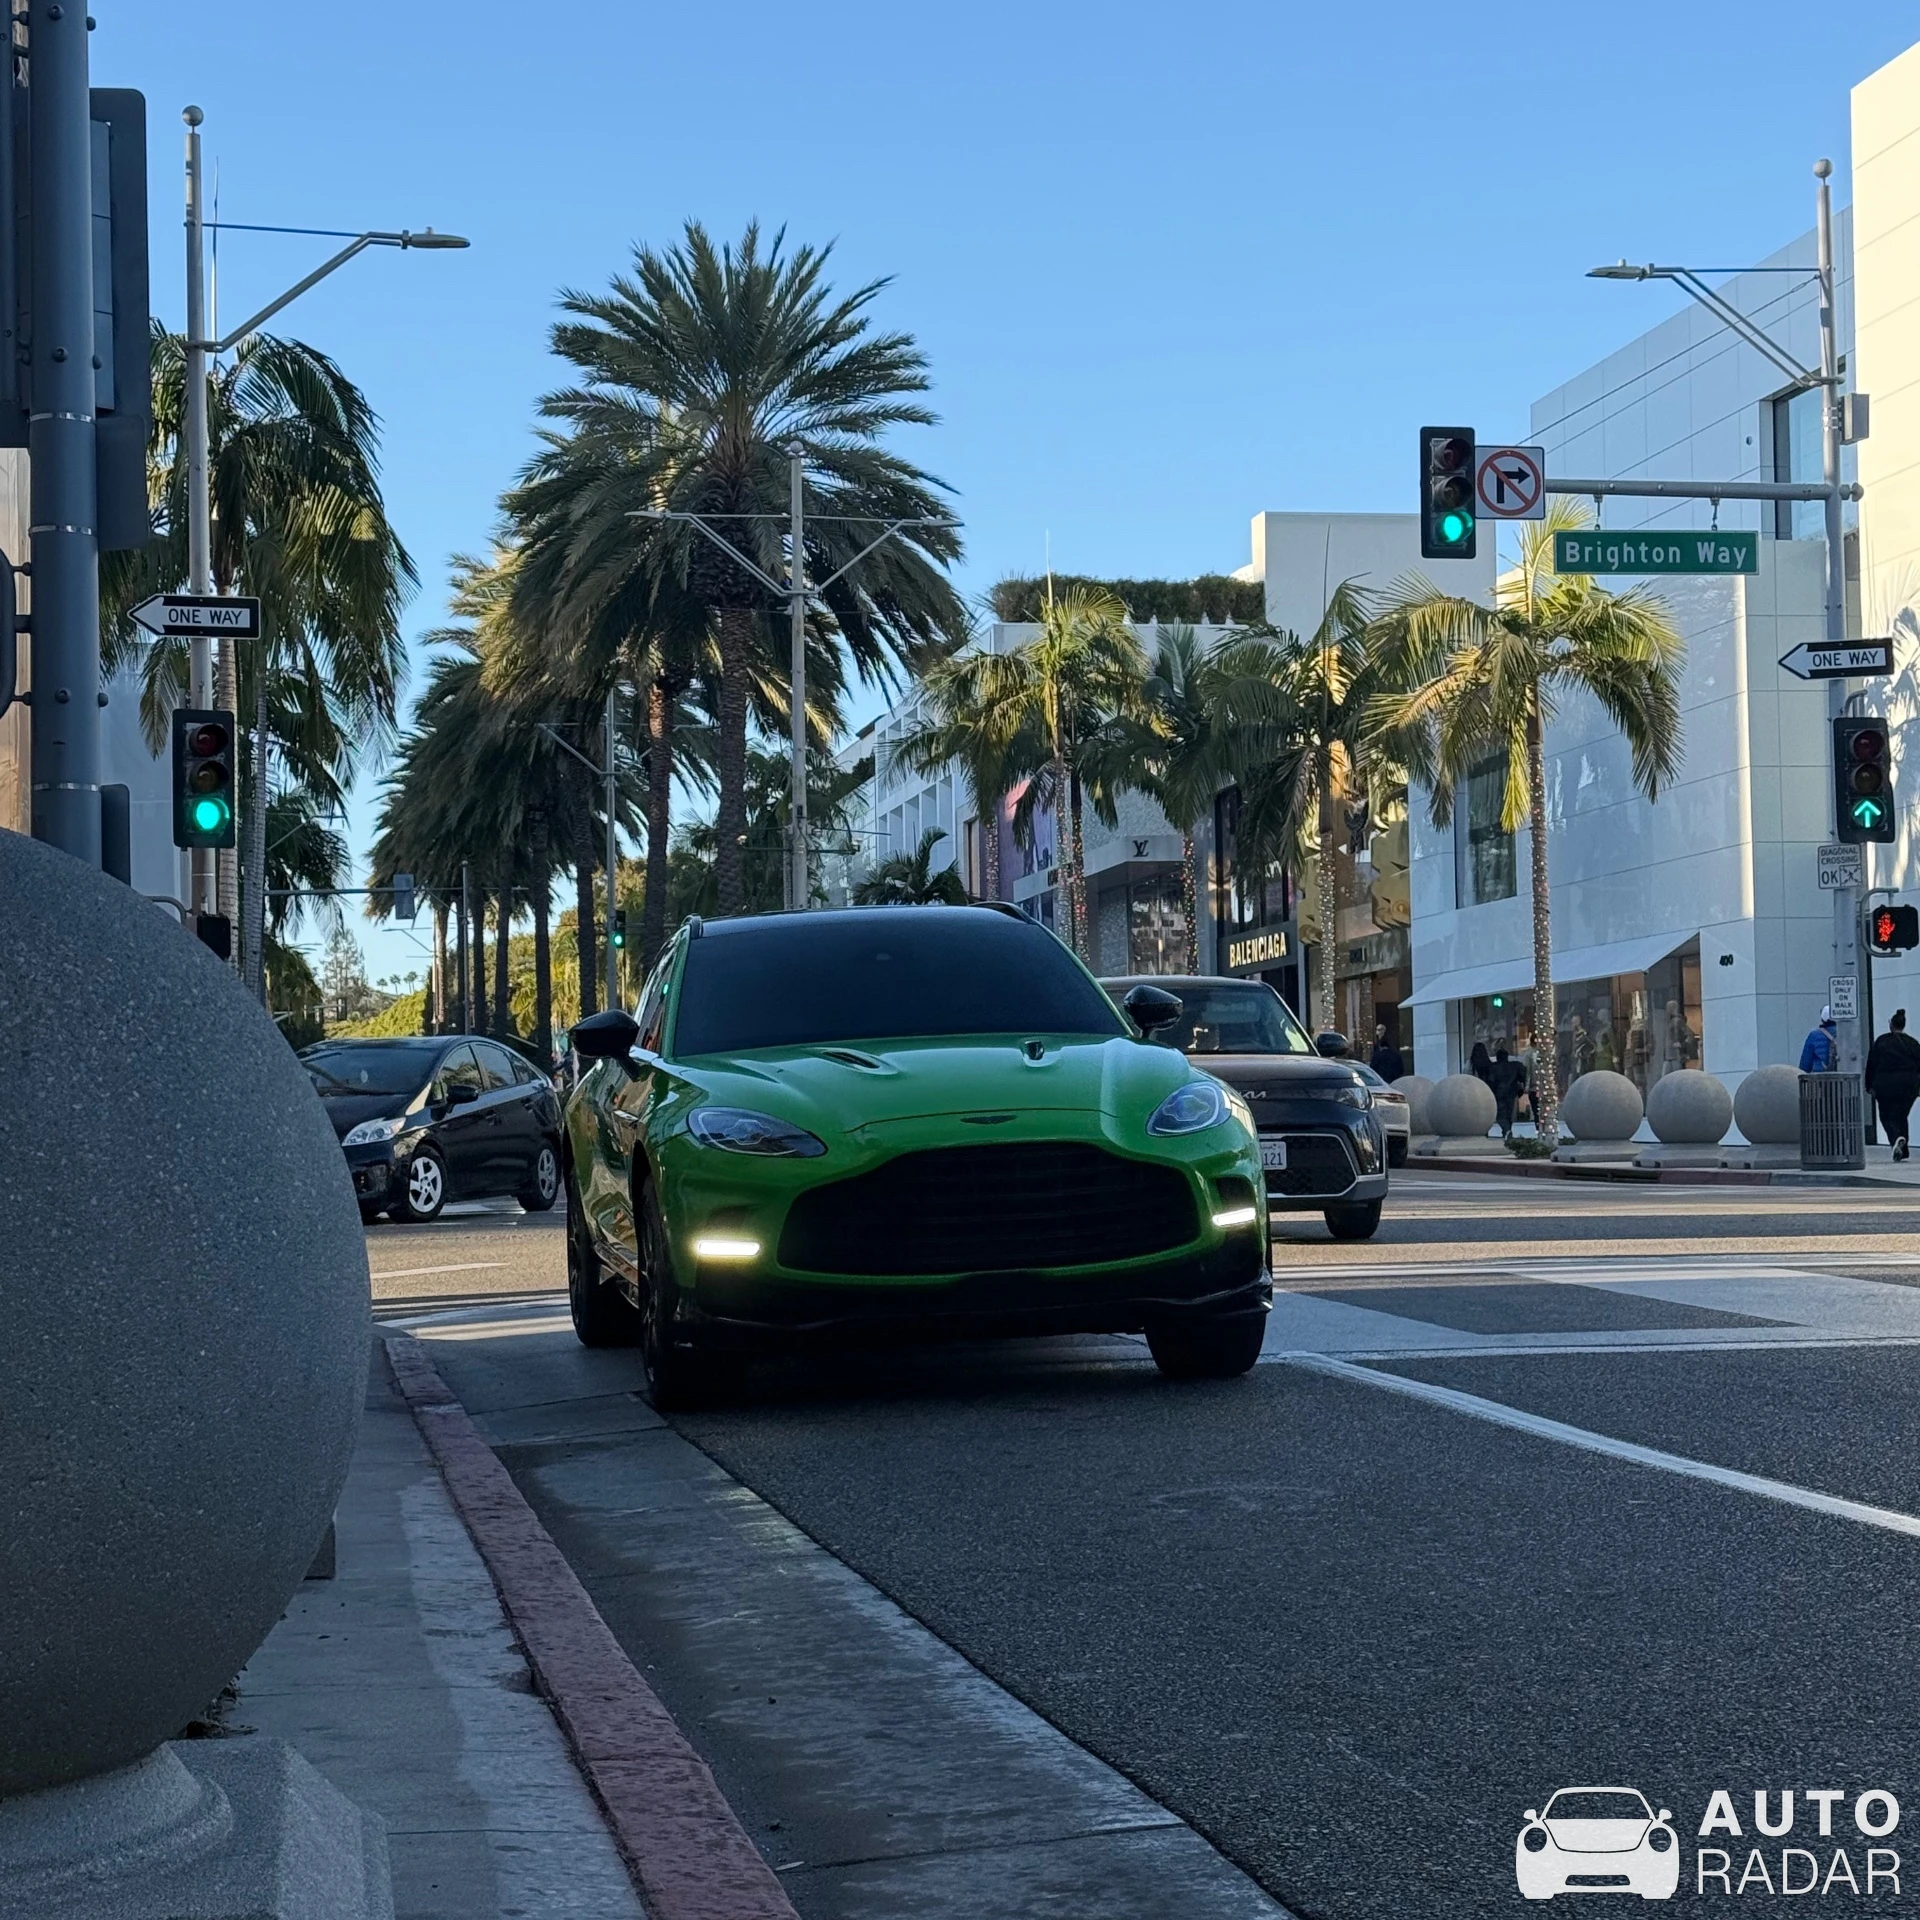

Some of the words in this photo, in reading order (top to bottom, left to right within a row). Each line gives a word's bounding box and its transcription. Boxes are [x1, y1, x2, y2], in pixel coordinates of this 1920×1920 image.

[1565, 541, 1681, 570] Brighton
[1697, 541, 1747, 569] Way
[168, 608, 202, 624] ONE
[209, 609, 243, 625] WAY
[1812, 652, 1842, 667] ONE
[1848, 650, 1879, 666] WAY
[1820, 846, 1859, 857] DIAGONAL
[1820, 855, 1859, 865] CROSSING
[1821, 869, 1839, 885] OK
[1229, 931, 1287, 968] BALENCIAGA
